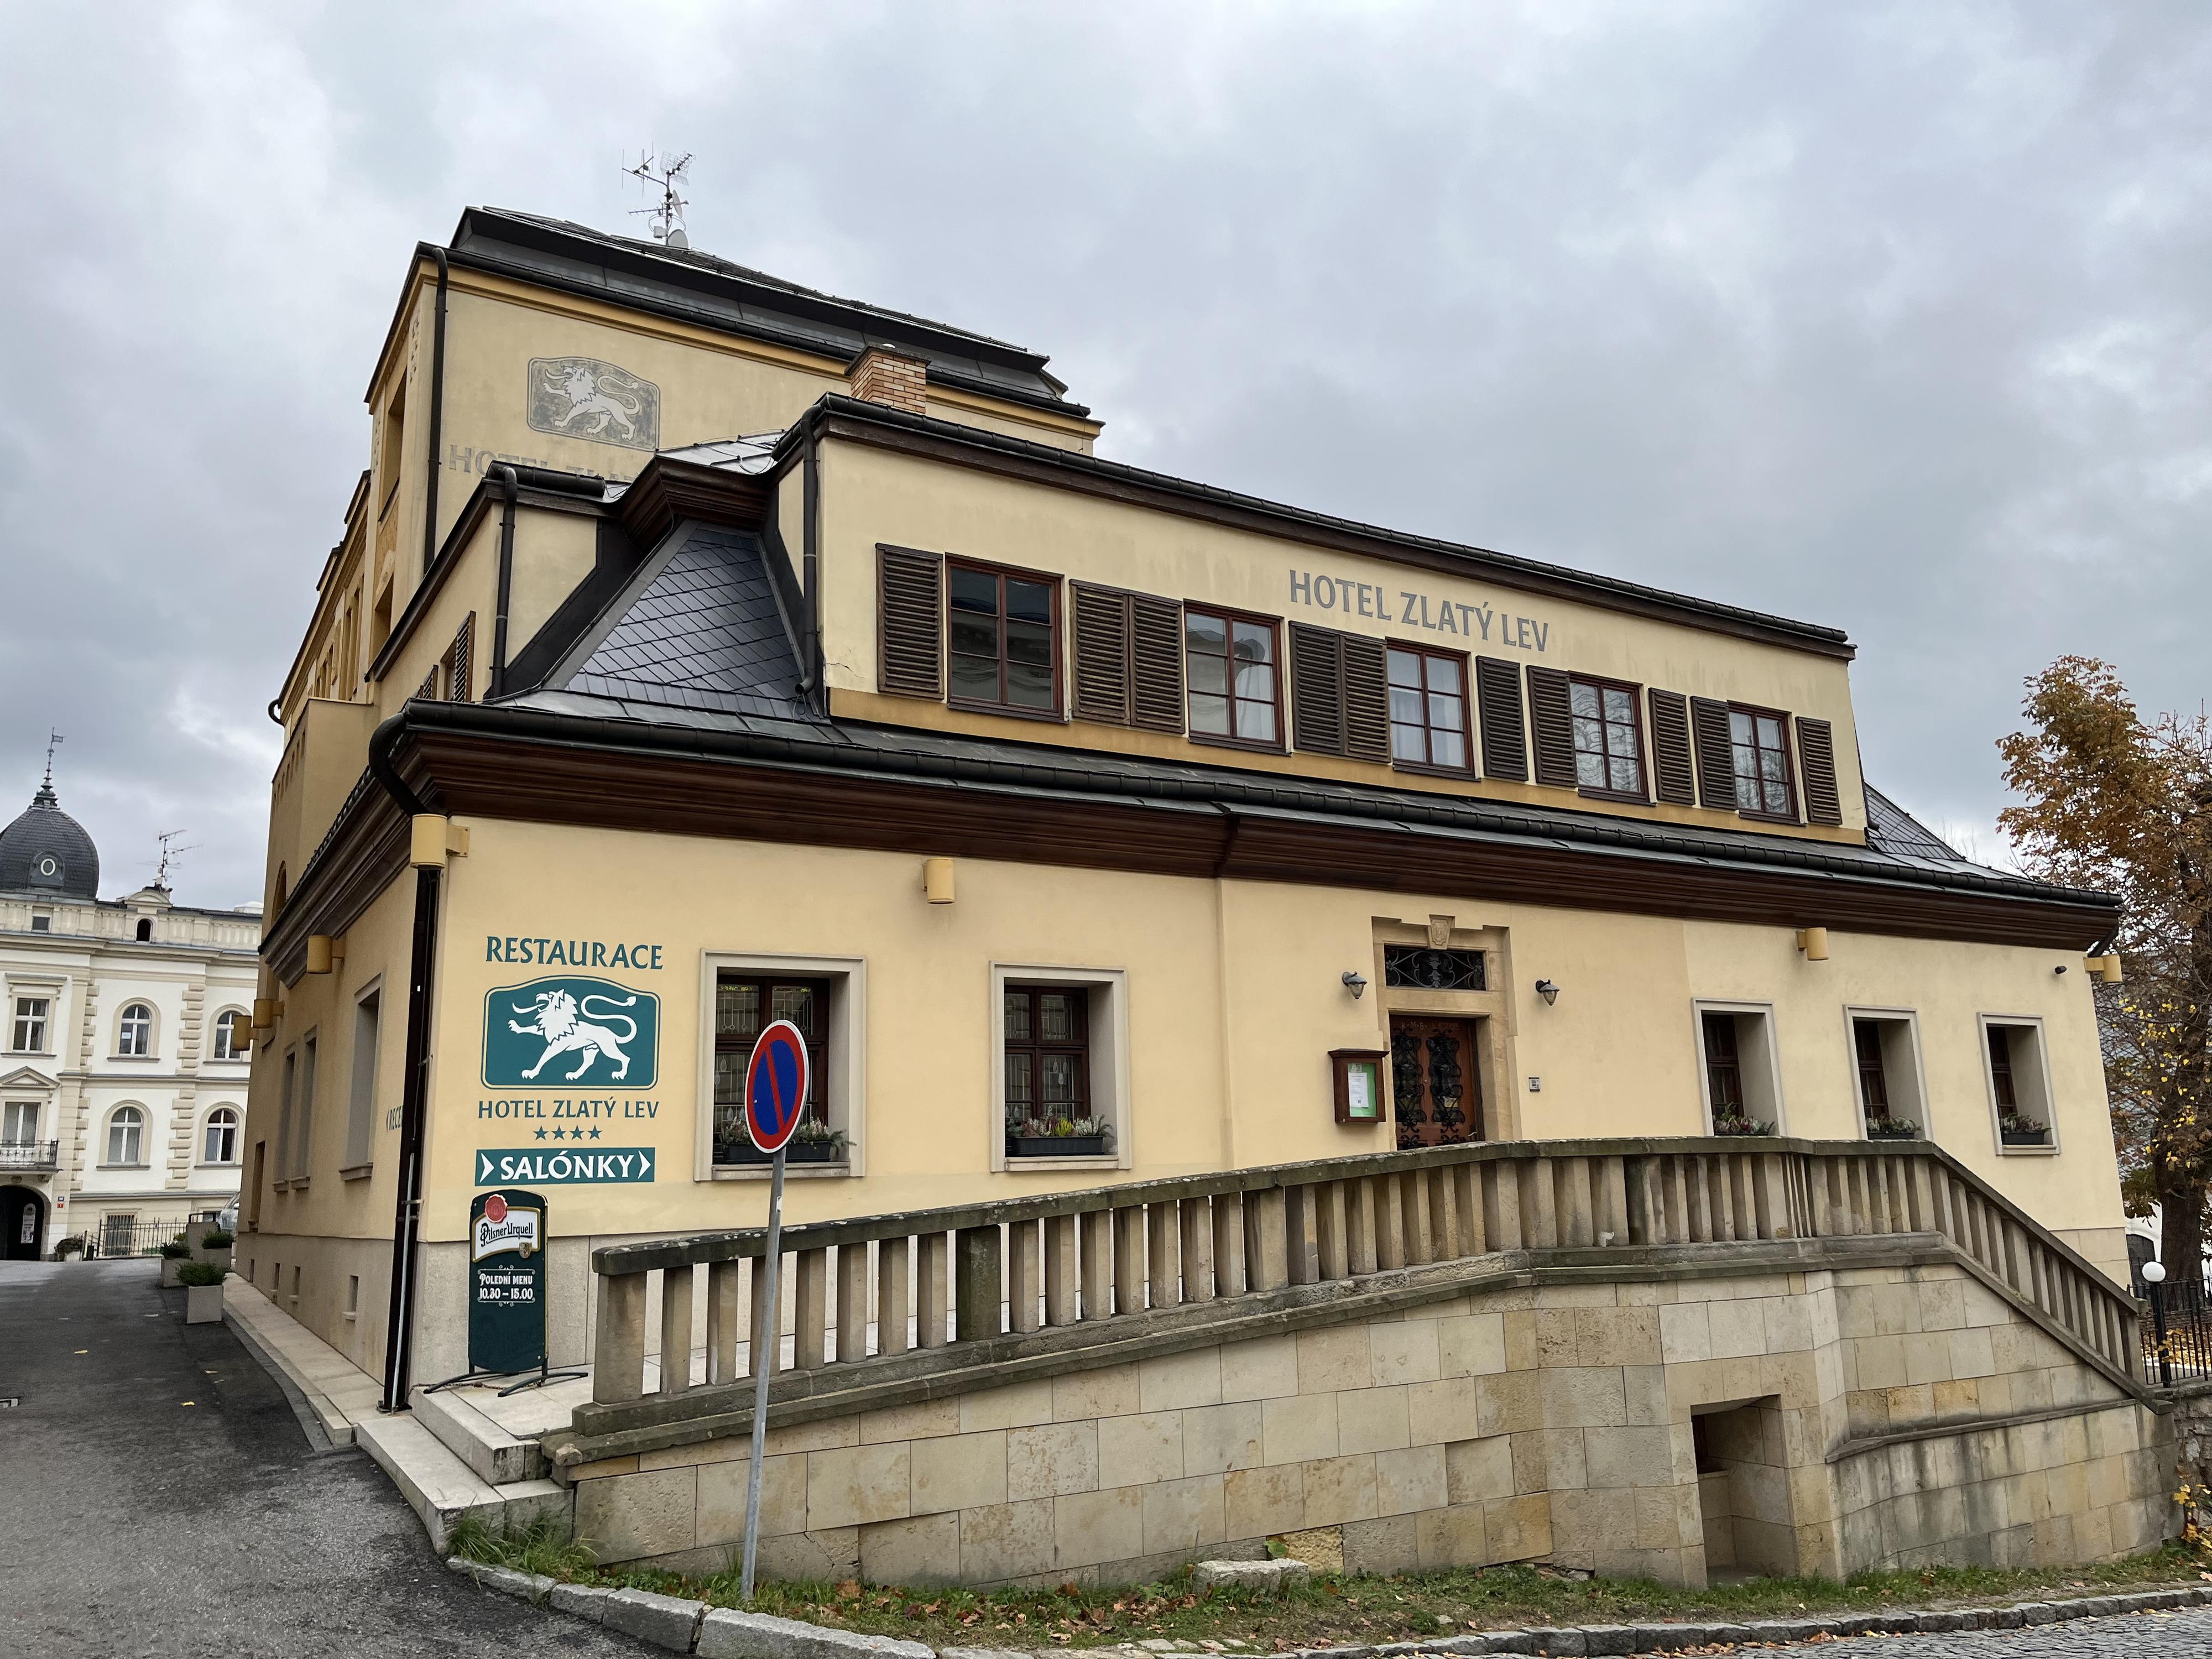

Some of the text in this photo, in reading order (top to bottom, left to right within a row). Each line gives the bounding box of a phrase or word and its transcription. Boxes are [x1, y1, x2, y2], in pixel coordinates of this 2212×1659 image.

[1289, 569, 1548, 652] HOTEL ZLATÝ LEV
[486, 936, 664, 970] RESTAURACE
[389, 1105, 403, 1131] RECE
[478, 1096, 660, 1119] HOTEL ZLATÝ LEV
[500, 1150, 634, 1181] SALÓNKY
[480, 1221, 533, 1248] Pilsner Urquell
[479, 1287, 501, 1300] 10.30
[510, 1287, 533, 1300] 15.00
